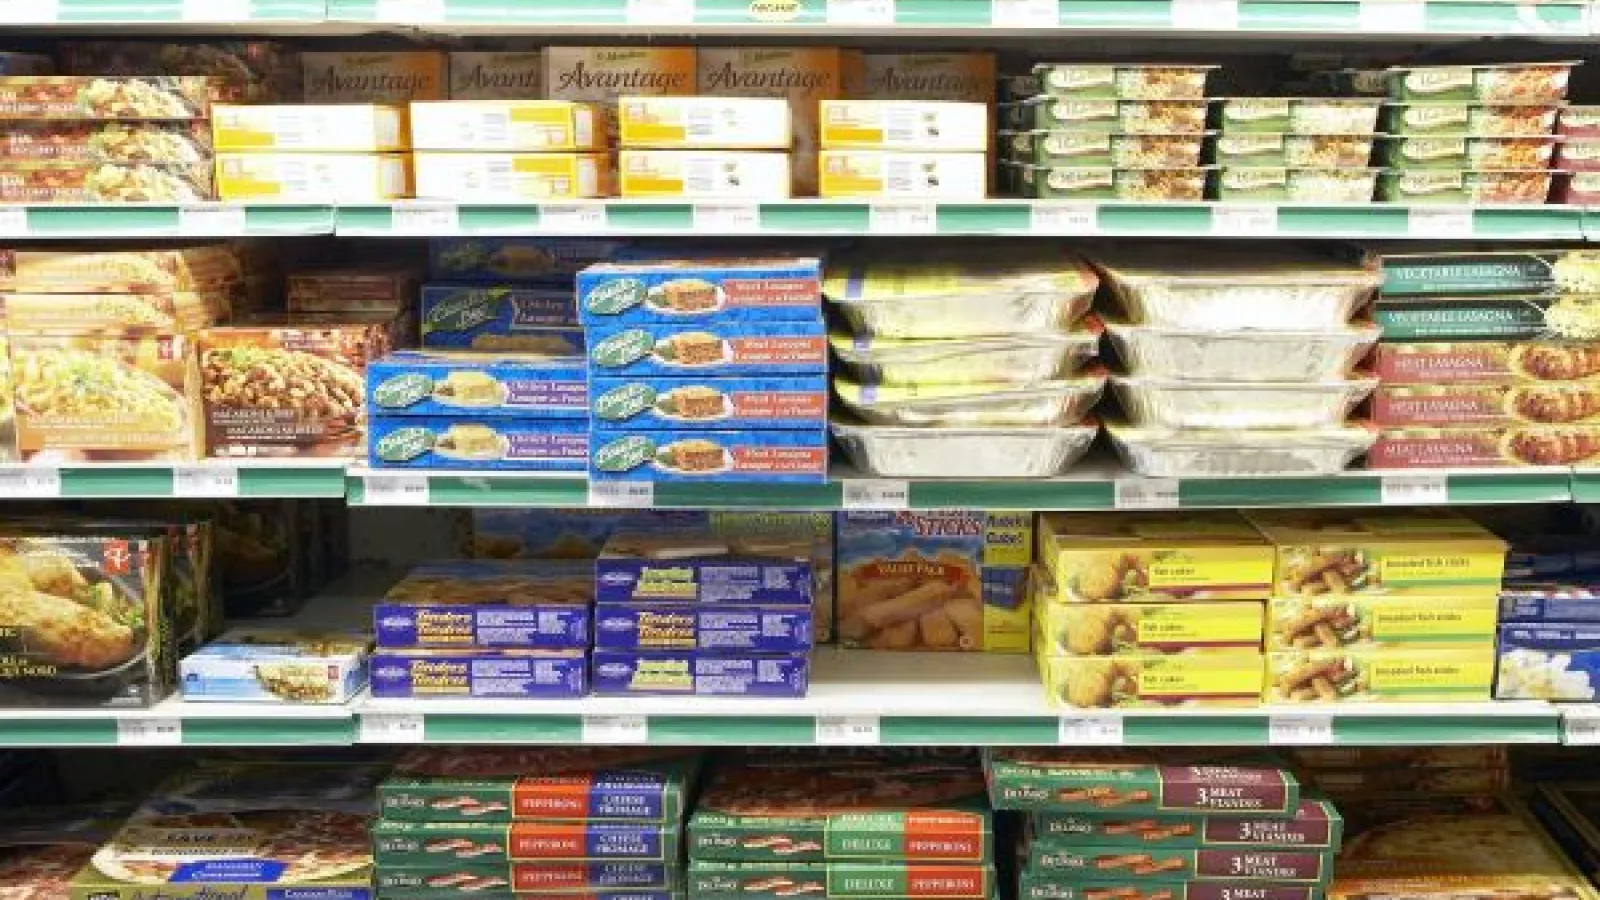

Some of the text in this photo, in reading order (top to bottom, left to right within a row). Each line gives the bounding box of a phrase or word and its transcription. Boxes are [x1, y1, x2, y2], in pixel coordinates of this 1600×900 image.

[311, 64, 431, 91] Avantage
[457, 64, 538, 89] Avant
[558, 61, 687, 93] Avantage
[706, 61, 831, 93] Avantage
[1396, 264, 1520, 280] VEGETABLE LASAGNA
[1388, 309, 1513, 323] VEGETABLE LASAGNA
[1428, 358, 1483, 369] LASAGNA
[916, 515, 982, 536] STICKS
[1196, 787, 1209, 804] 3
[1210, 787, 1243, 798] MEAT
[521, 799, 581, 810] PEPPERONI
[602, 794, 646, 805] CHEESE
[1239, 821, 1251, 841] 3
[519, 839, 577, 849] PEPPERONI
[841, 838, 893, 850] DELUXE
[909, 842, 973, 853] PEPPERONI
[1231, 856, 1242, 874] 3
[1244, 854, 1277, 866] MEAT
[844, 877, 894, 890] DELUXE
[912, 879, 975, 890] PEPPERONI
[1233, 888, 1267, 899] MEAT
